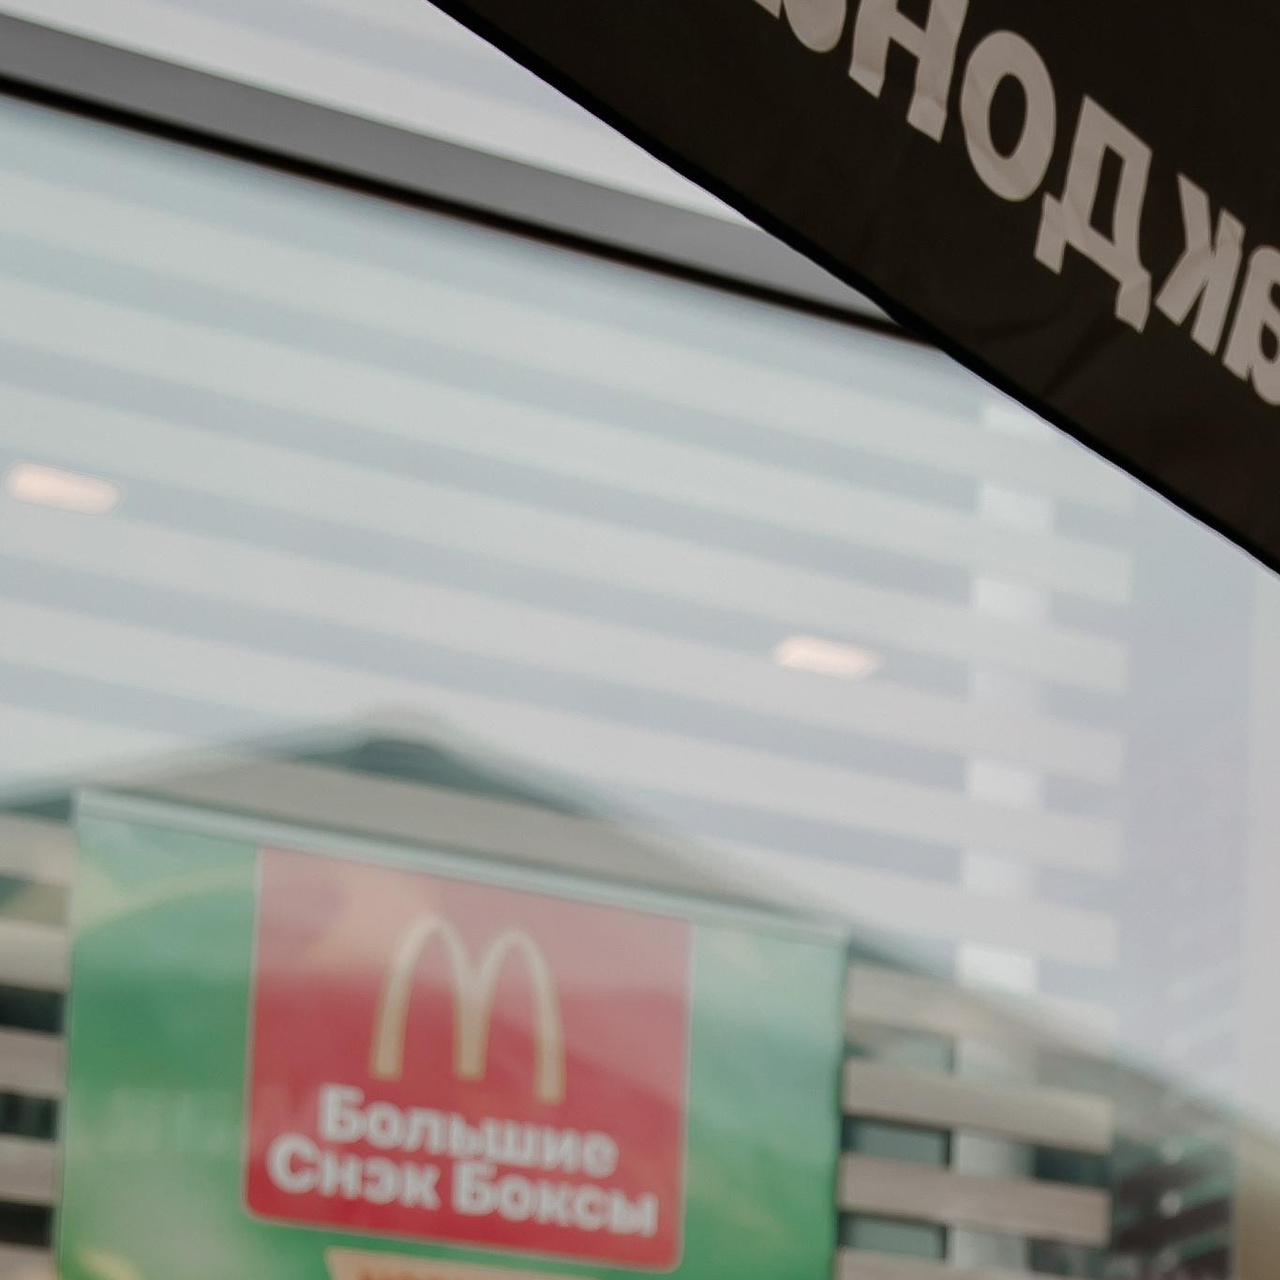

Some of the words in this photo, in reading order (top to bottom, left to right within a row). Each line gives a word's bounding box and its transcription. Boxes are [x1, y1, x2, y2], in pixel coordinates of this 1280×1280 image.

[319, 1082, 619, 1178] Большие
[266, 1132, 442, 1211] Снэк
[450, 1160, 660, 1237] Боксы
